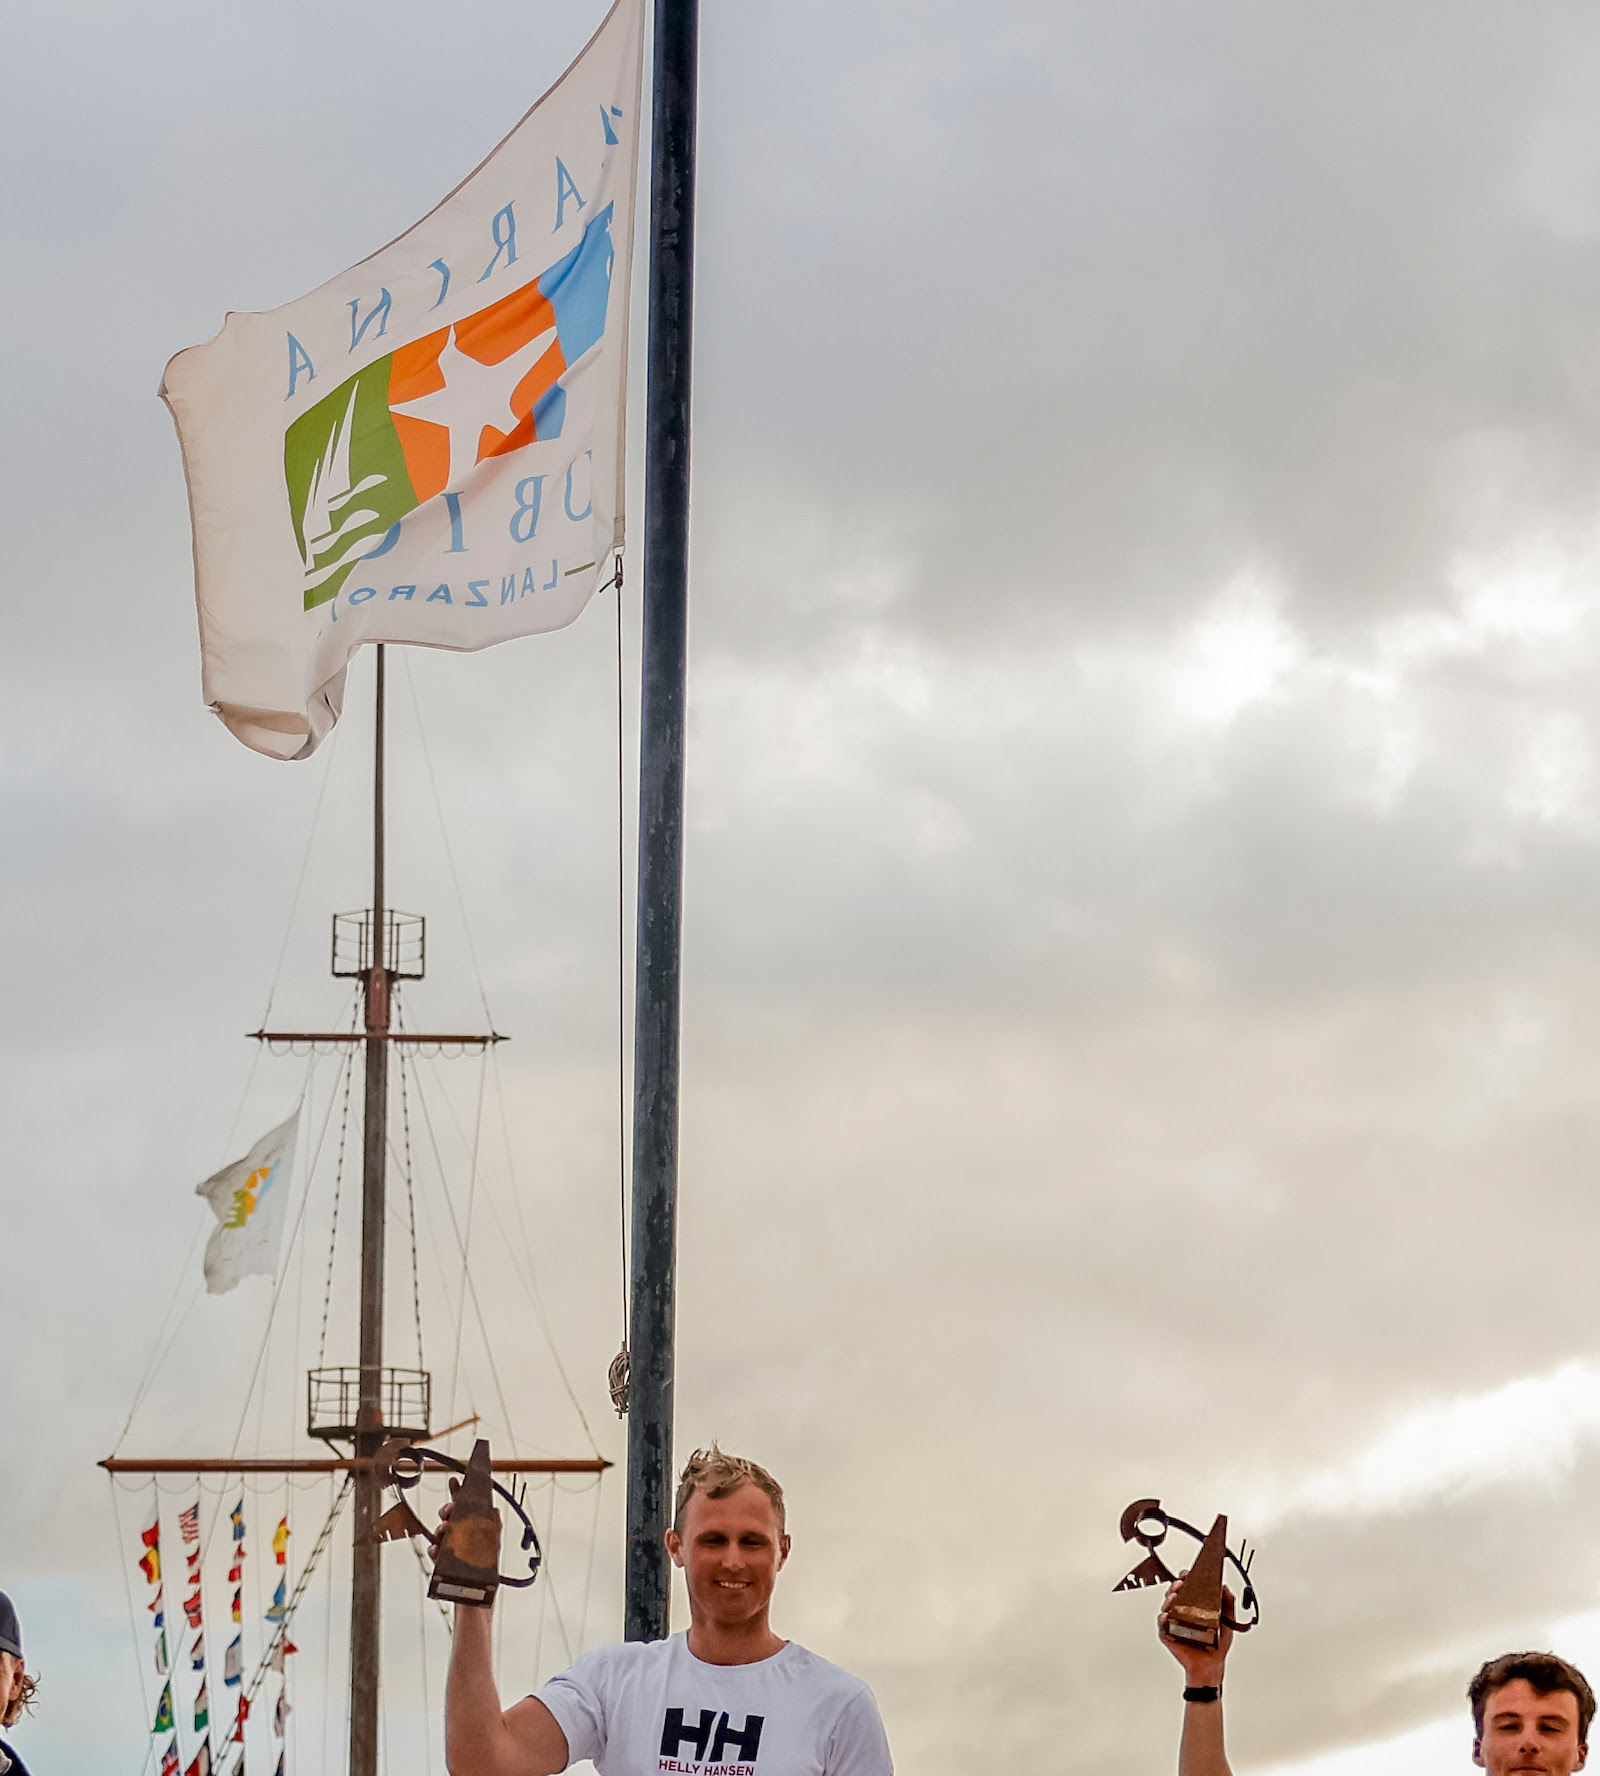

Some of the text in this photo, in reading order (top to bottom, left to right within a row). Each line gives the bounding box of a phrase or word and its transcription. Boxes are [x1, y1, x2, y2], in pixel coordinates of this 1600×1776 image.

[660, 1707, 765, 1762] HH
[659, 1759, 755, 1776] HELLY HANSEN
